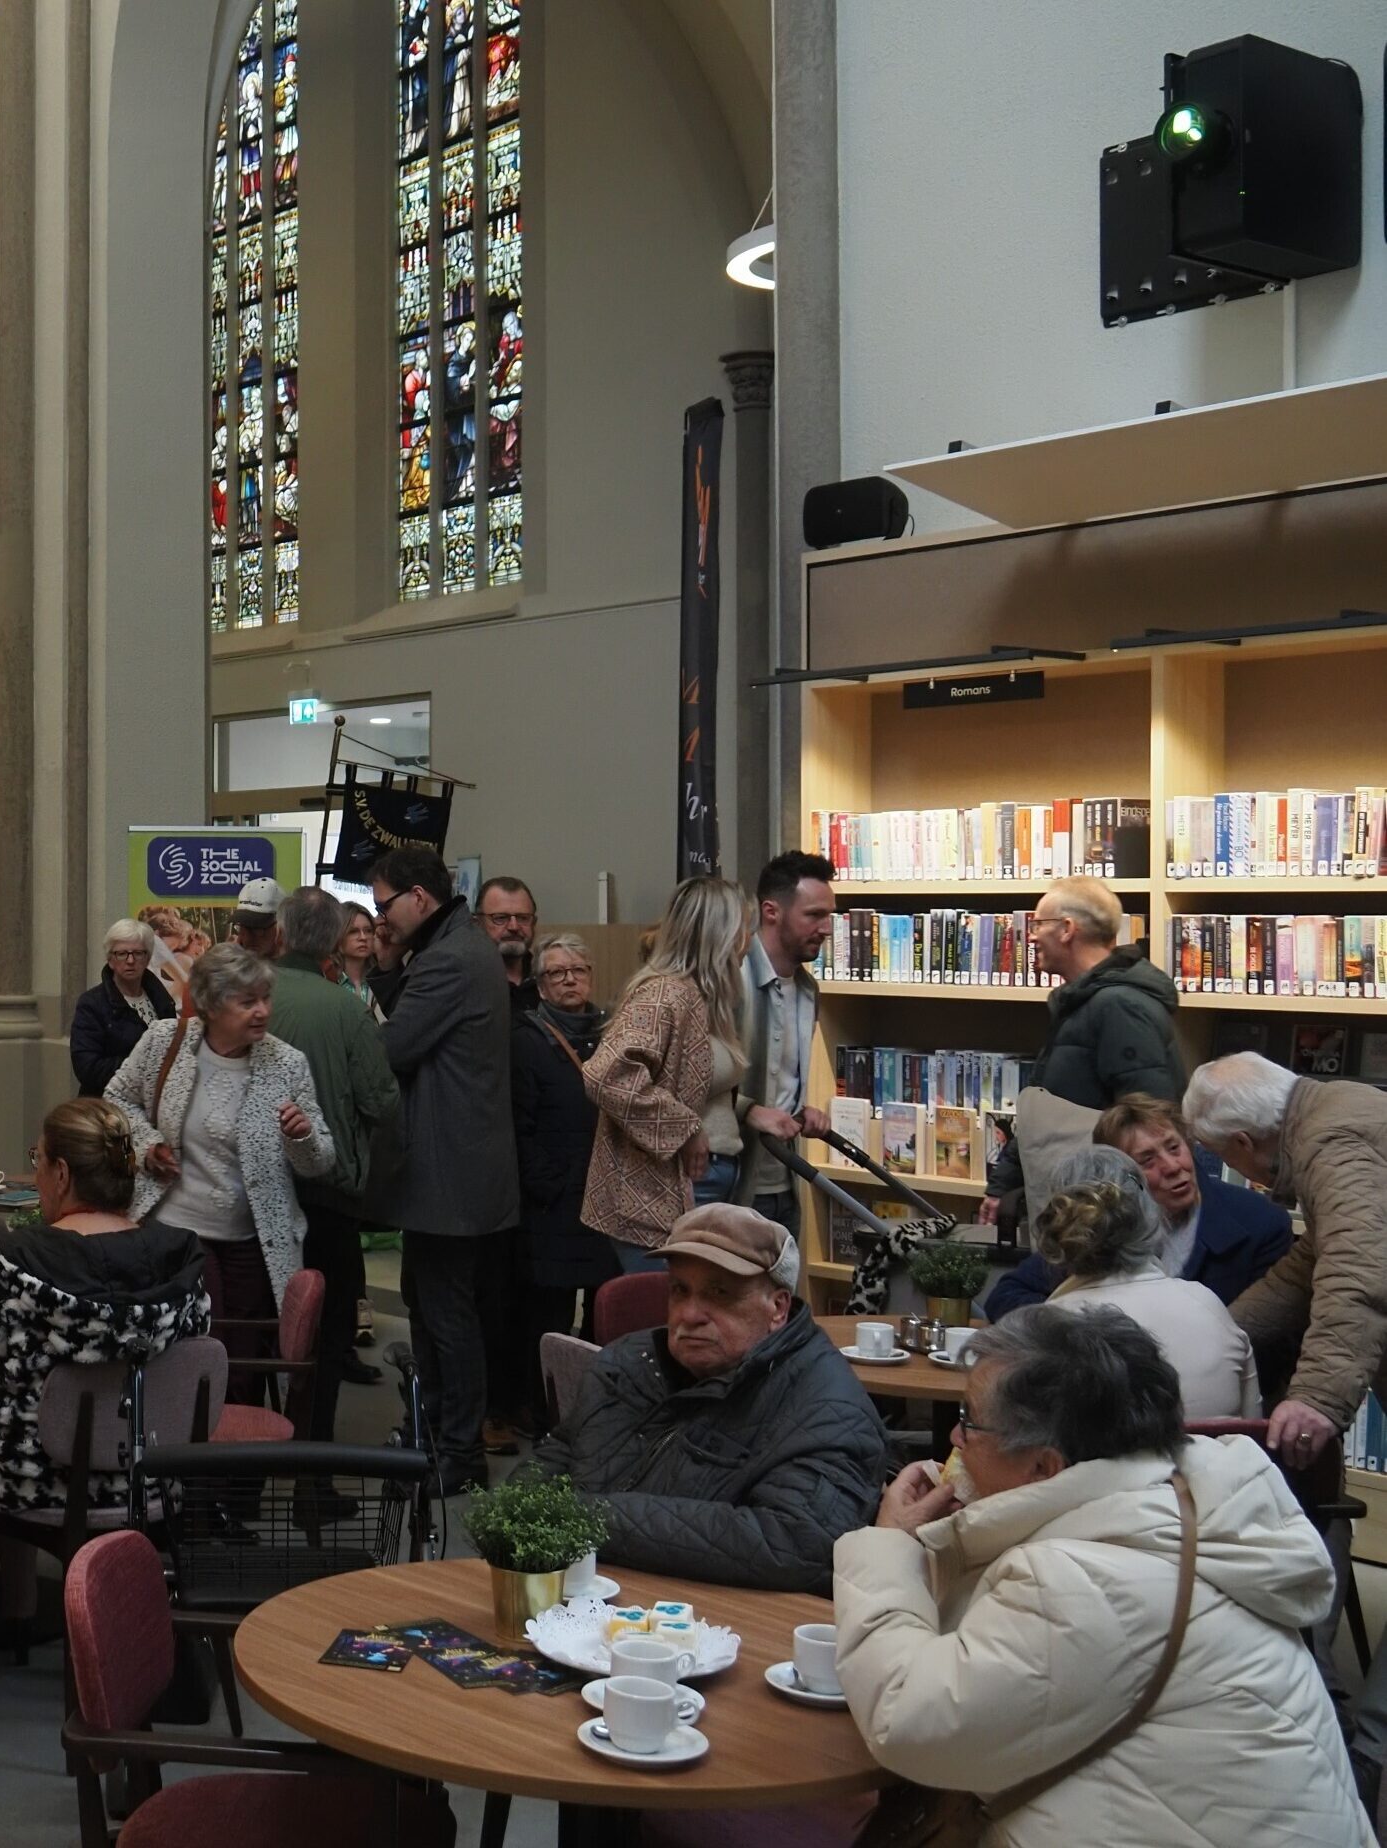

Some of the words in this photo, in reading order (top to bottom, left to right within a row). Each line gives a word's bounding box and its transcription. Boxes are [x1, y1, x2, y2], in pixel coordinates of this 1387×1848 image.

[950, 686, 991, 697] Romans
[358, 809, 377, 830] DE
[1291, 813, 1299, 839] MEYER
[1304, 813, 1312, 840] MEYER
[200, 848, 240, 860] THE
[200, 860, 263, 872] SOCIAL
[200, 873, 251, 885] ZONE
